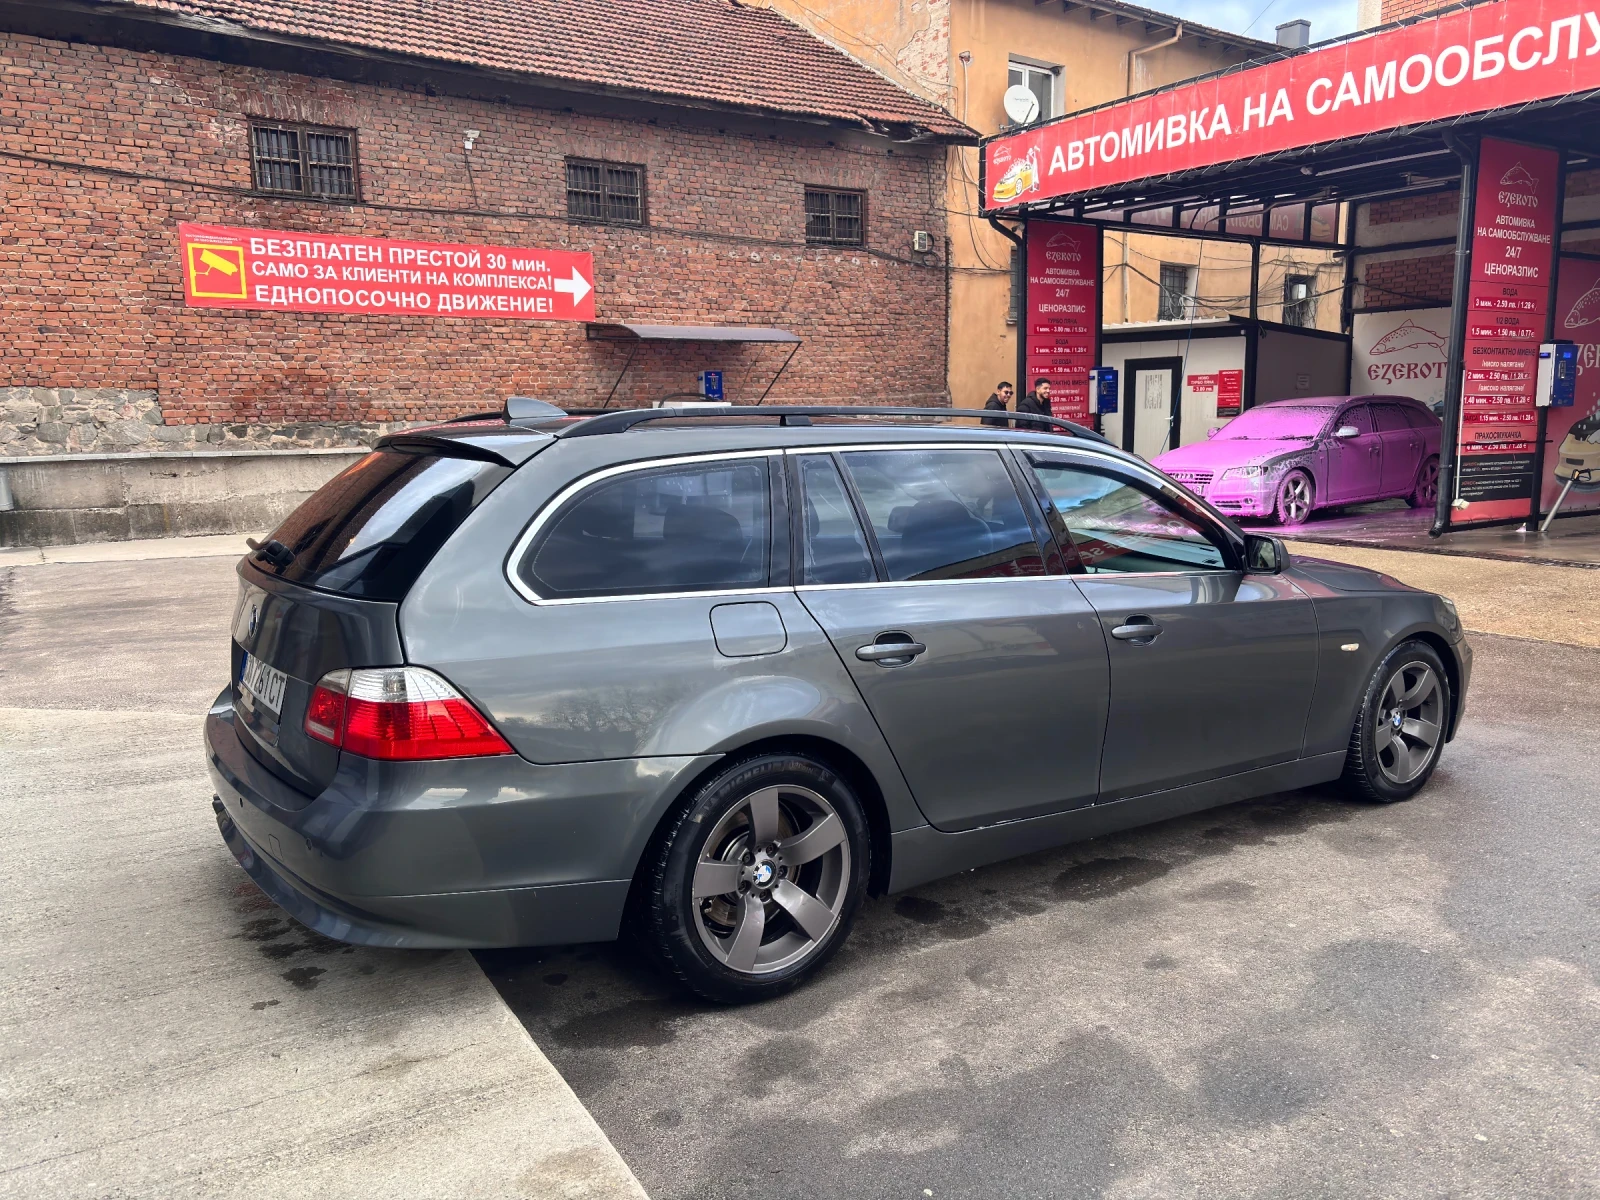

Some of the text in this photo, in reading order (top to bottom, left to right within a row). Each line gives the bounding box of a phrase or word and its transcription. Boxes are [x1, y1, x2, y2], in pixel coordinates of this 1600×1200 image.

[1048, 103, 1232, 176] АВТОМИВКА
[1243, 87, 1294, 131] НА
[1495, 214, 1535, 228] АВТОМИВКА
[1477, 227, 1551, 244] НА САМООБСЛУЖВАНЕ
[250, 237, 382, 263] БЕЗПЛАТЕН
[389, 248, 481, 269] ПРЕСТОЙ
[486, 254, 506, 270] 30
[512, 259, 550, 272] мин.
[1505, 245, 1522, 259] 24/7
[1045, 268, 1080, 276] АВТОМИВКА
[1484, 262, 1539, 278] ЦЕНОРАЗПИС
[252, 261, 552, 290] САМО ЗА КЛИЕНТИ НА КОМПЛЕКСА!
[1040, 277, 1095, 287] САМООБСЛУЖВАНЕ
[1055, 288, 1070, 298] 24/7
[1502, 288, 1518, 297] ВОДА
[255, 284, 553, 313] ЕДНОПОСОЧНО ДВИЖЕНИЕ!
[1496, 299, 1508, 308] 2.50
[1038, 303, 1086, 314] ЦЕНОРАЗПИС
[1504, 317, 1520, 326] ВОДА
[1471, 327, 1480, 335] 1.5
[1497, 328, 1508, 336] 1.50
[1472, 346, 1517, 355] БЕЗКОНТАКТНО
[1492, 396, 1503, 404] 2.50
[1474, 431, 1522, 440] ПРАХОСМУКАЧКА
